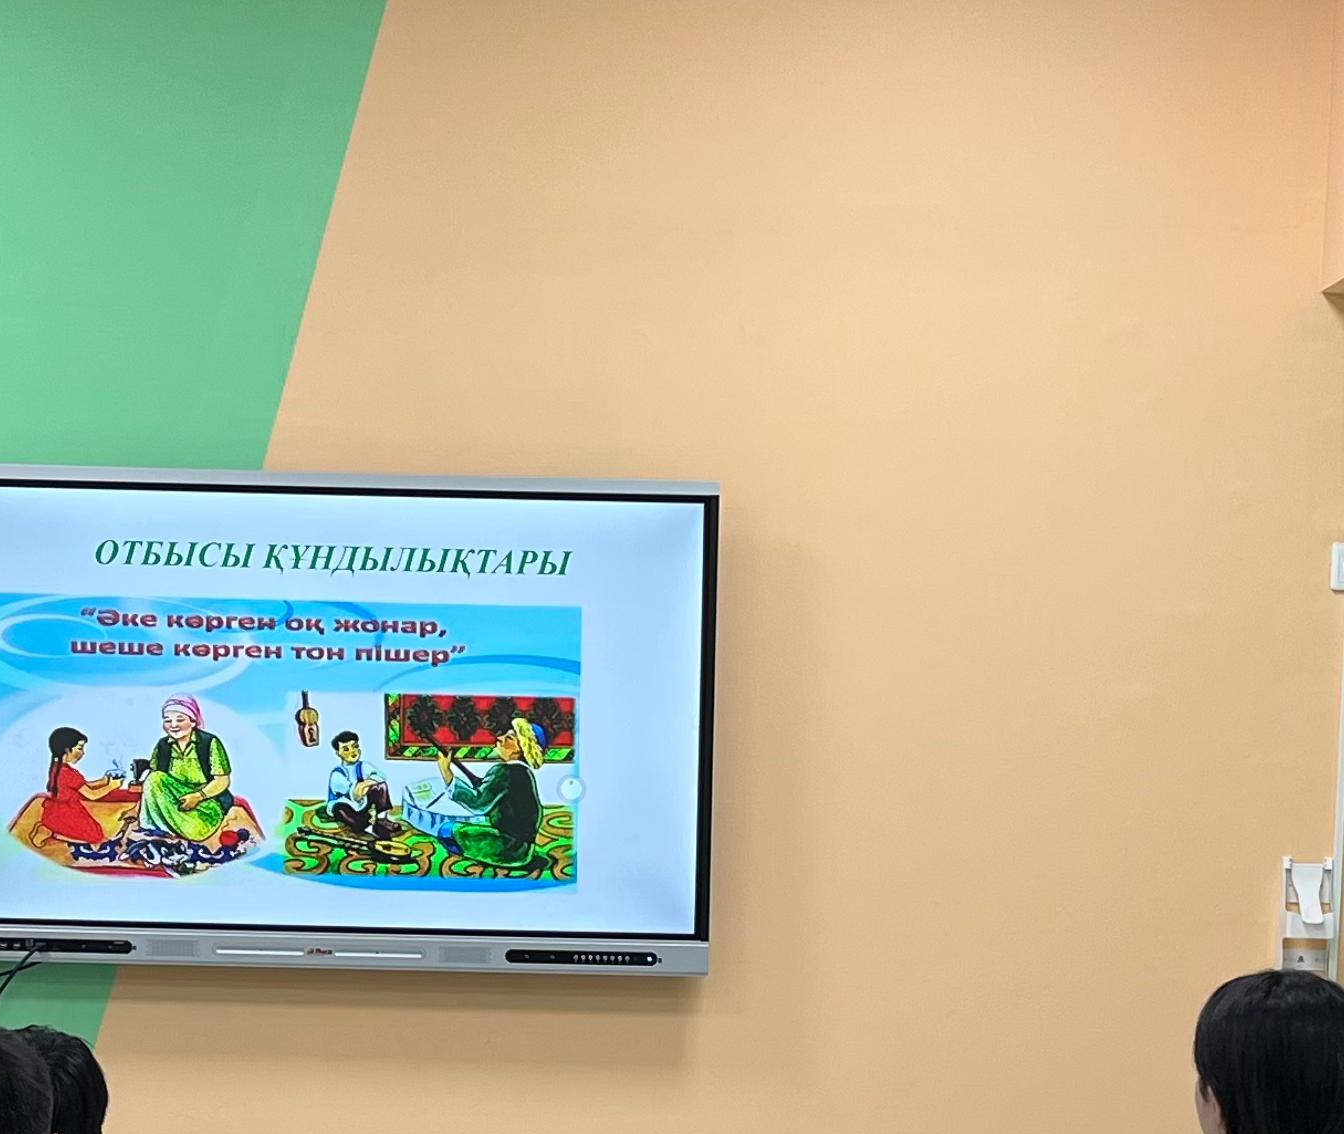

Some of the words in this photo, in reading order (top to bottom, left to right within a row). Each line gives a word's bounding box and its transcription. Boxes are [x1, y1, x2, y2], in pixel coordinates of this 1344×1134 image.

[95, 539, 256, 568] ОТБЫСЫ
[262, 543, 574, 579] ҚҰНДЫЛЫҚТАРЫ
[166, 613, 276, 632] көрген
[284, 617, 325, 635] оқ
[333, 617, 448, 638] жонар,
[70, 640, 164, 656] шеше
[173, 642, 283, 661] көрген
[290, 645, 345, 661] тон
